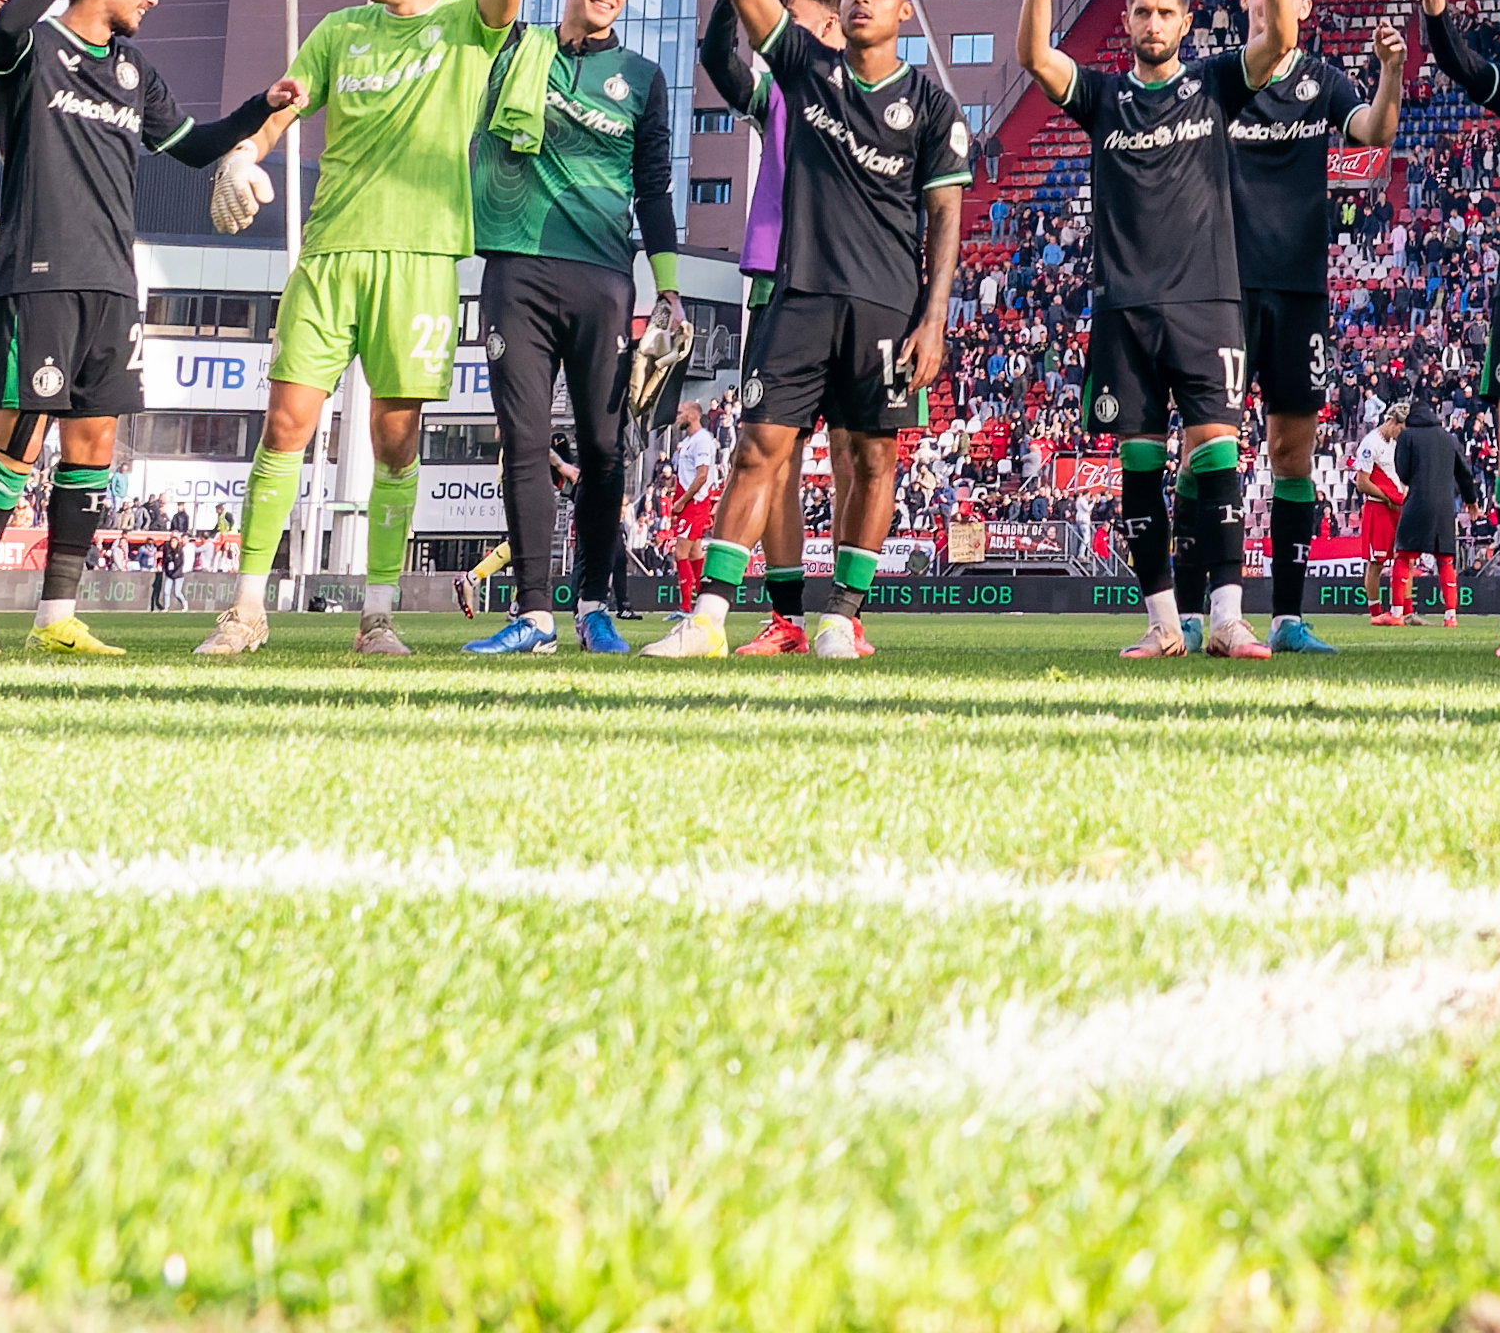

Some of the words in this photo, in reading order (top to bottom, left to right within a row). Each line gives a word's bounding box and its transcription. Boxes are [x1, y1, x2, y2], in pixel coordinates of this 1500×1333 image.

[411, 313, 453, 359] 22
[176, 355, 246, 390] UTB
[454, 361, 491, 394] TB
[1218, 346, 1246, 391] 17
[988, 523, 1031, 537] MEMORY
[867, 585, 913, 605] FITS
[918, 585, 961, 605] THE
[967, 585, 1013, 605] JOB
[1093, 585, 1140, 606] FITS
[1319, 586, 1367, 606] FITS
